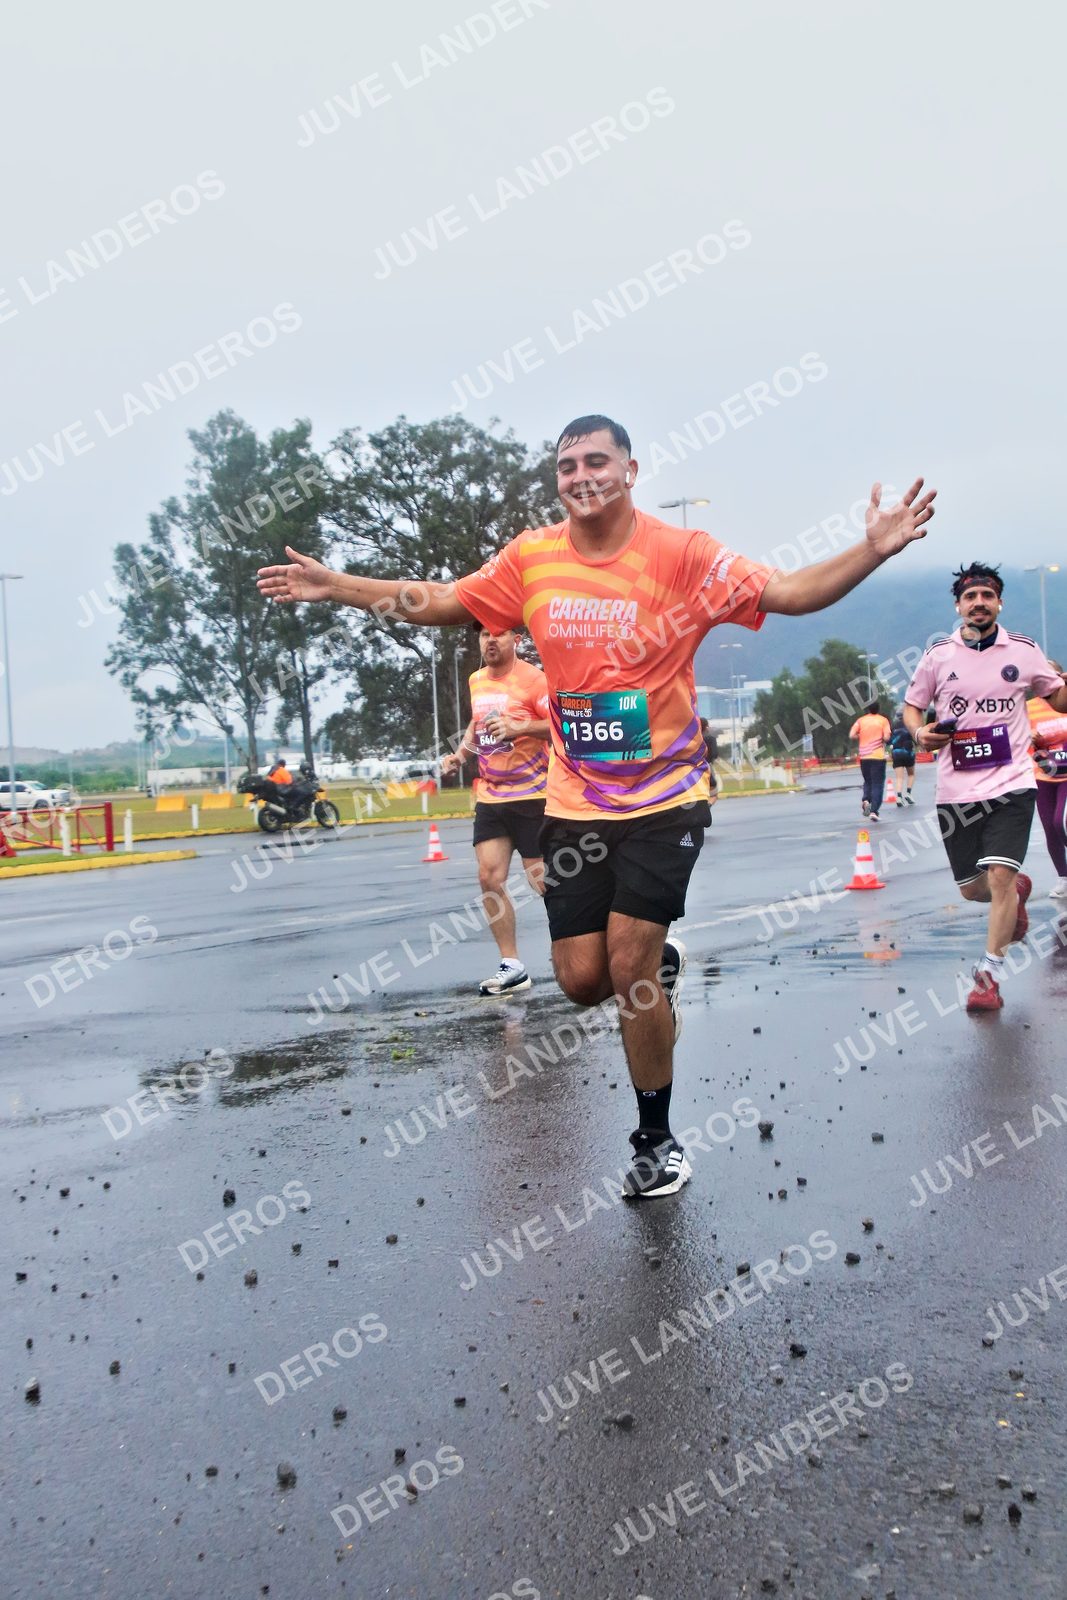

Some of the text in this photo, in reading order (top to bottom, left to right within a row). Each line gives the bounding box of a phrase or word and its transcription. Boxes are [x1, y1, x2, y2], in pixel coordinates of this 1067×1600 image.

[549, 597, 638, 623] CARRERA
[560, 698, 592, 710] CARRERA
[619, 696, 637, 710] 10K
[975, 698, 1016, 714] XBTO
[570, 722, 624, 742] 1366
[964, 744, 992, 758] 253
